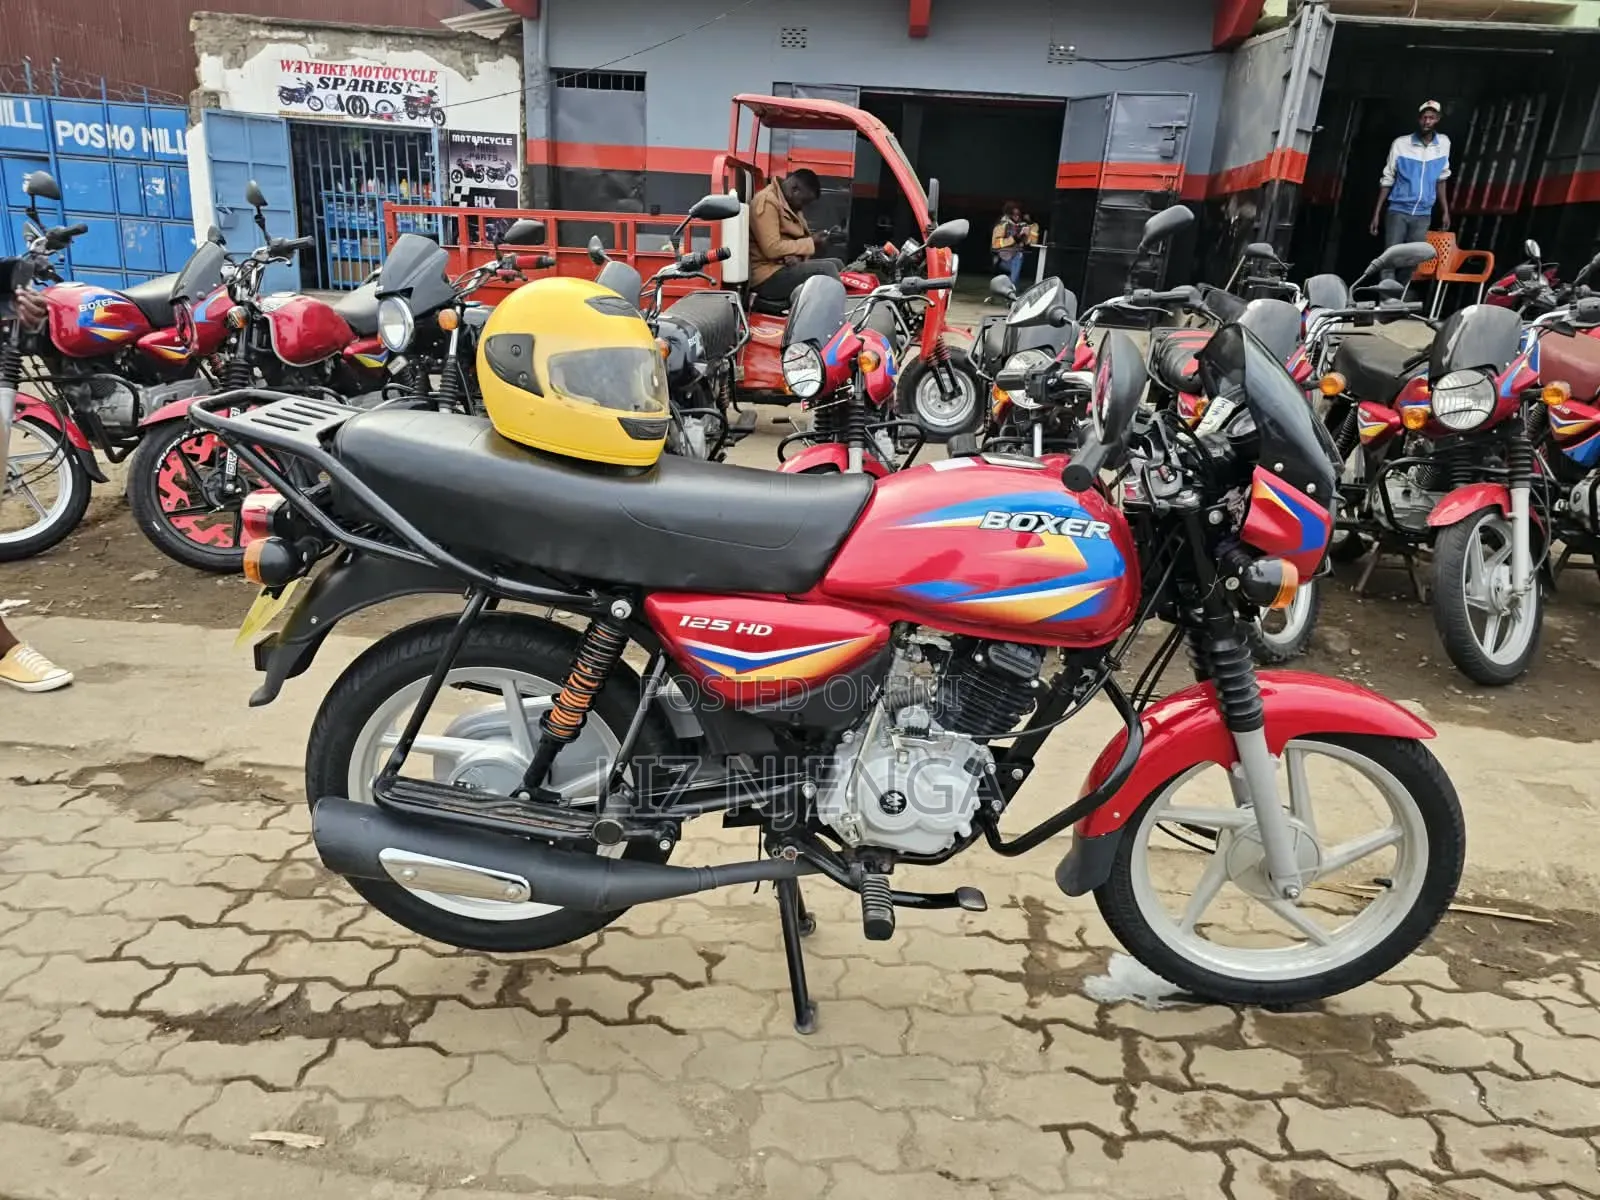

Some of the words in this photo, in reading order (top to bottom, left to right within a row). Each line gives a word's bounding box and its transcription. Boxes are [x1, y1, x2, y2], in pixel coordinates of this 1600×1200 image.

[280, 59, 348, 77] WAYBIKE
[350, 65, 438, 84] MOTOCYCLE
[317, 76, 403, 95] SPARES
[0, 100, 43, 130] ILL
[55, 120, 135, 151] POSHO
[452, 134, 513, 146] MOTORCYCLE
[474, 195, 496, 209] HLX
[978, 510, 1111, 540] BOXER
[679, 615, 733, 631] 125
[735, 622, 773, 636] HD
